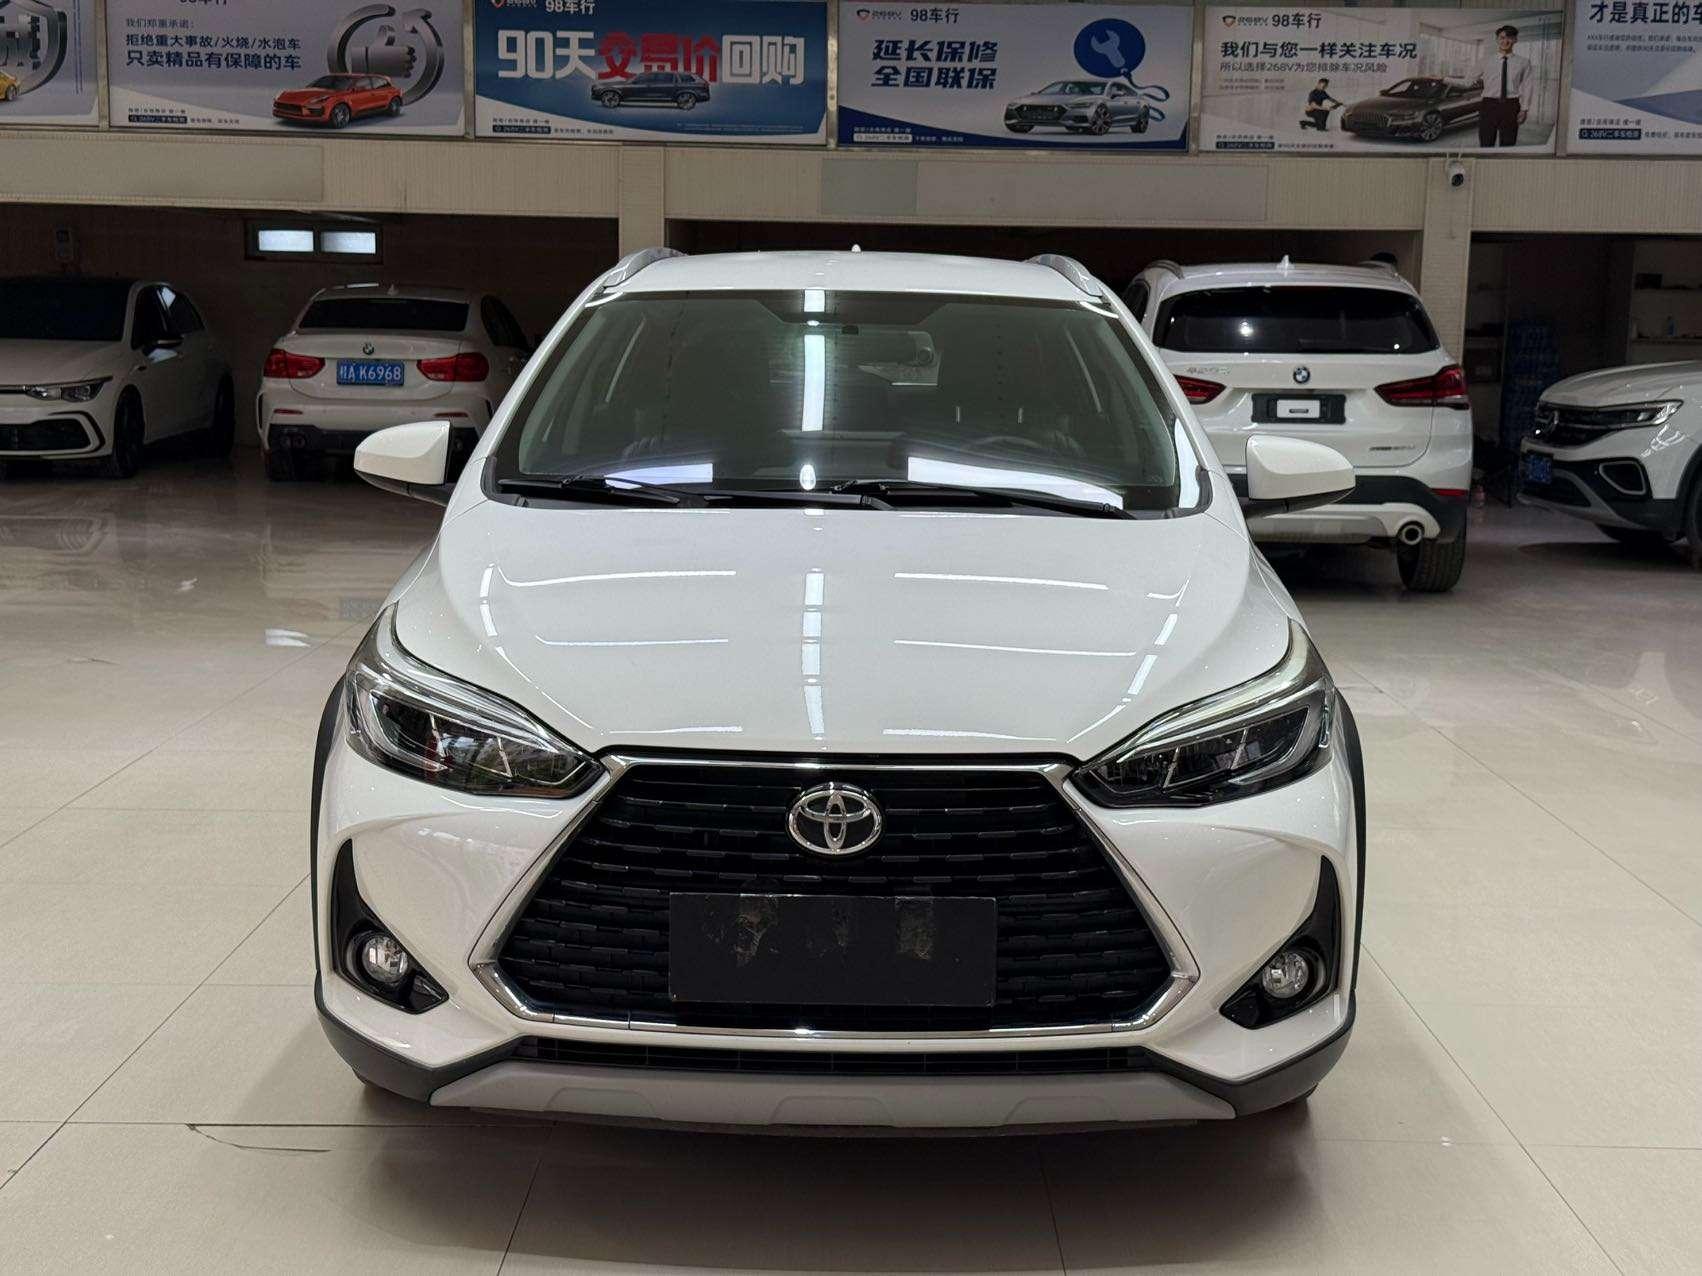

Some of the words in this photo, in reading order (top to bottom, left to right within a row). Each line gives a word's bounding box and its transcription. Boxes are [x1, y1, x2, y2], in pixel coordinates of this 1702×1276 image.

[545, 0, 595, 15] 98车行
[910, 8, 960, 24] 98车行
[1271, 12, 1322, 29] 98车行
[126, 33, 301, 50] 拒绝重大事故/火烧/水泡车
[1220, 41, 1418, 59] 我们与您一样关注车况
[497, 29, 806, 85] 90天交易价回购
[872, 39, 999, 63] 延长保修
[126, 50, 302, 70] 只卖精品有保障的车
[1219, 62, 1388, 73] 所以选择268V为您排除车况风险
[871, 65, 998, 89] 全国联保
